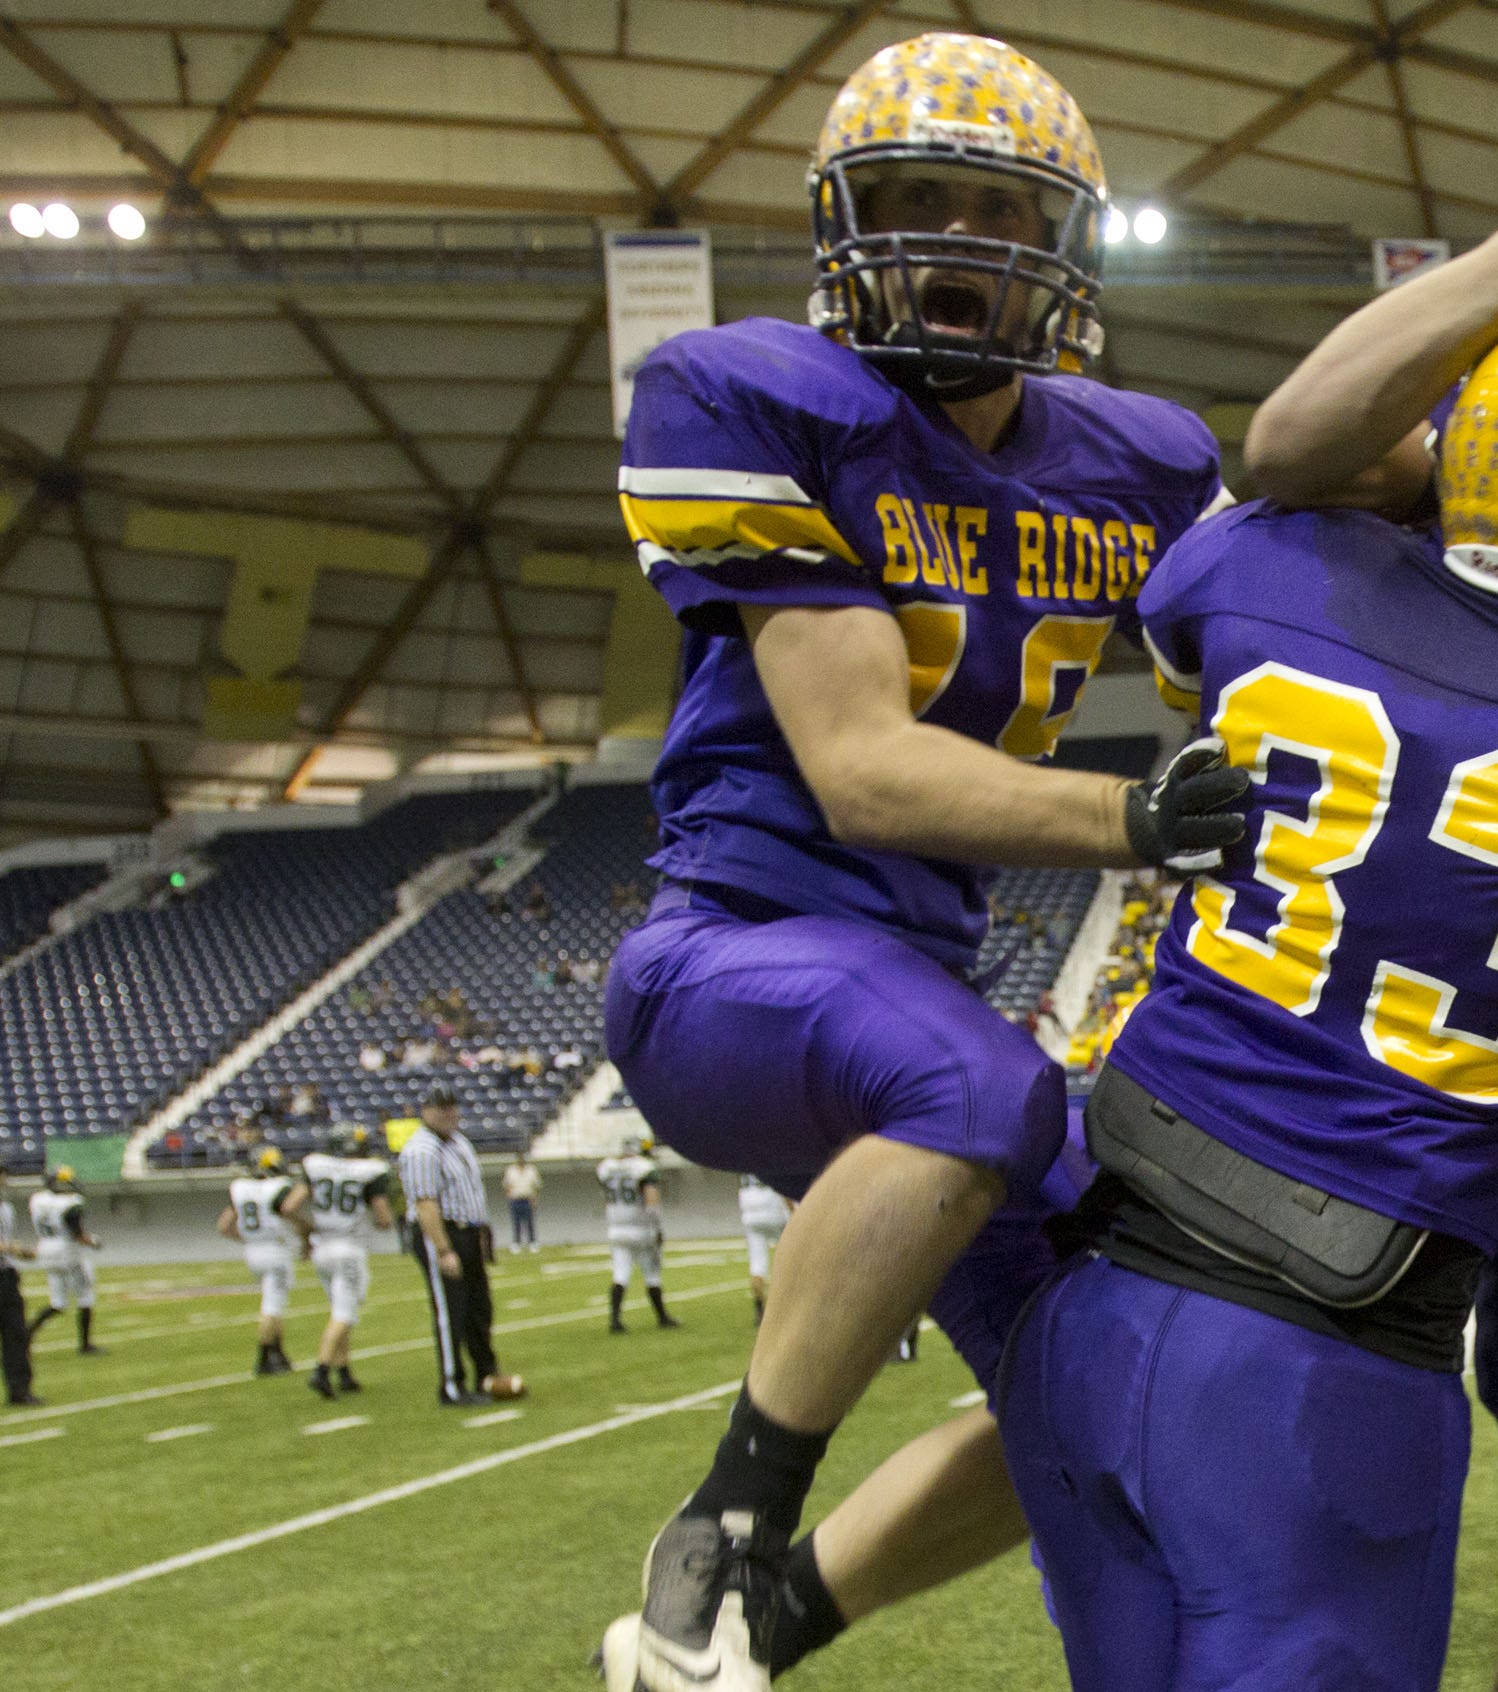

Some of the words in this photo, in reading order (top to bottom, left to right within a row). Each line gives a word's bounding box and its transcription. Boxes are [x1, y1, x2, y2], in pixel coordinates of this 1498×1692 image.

[875, 493, 989, 595] BLUE
[1015, 510, 1155, 601] RIDGE
[314, 1178, 358, 1214] 36
[243, 1201, 260, 1231] 8
